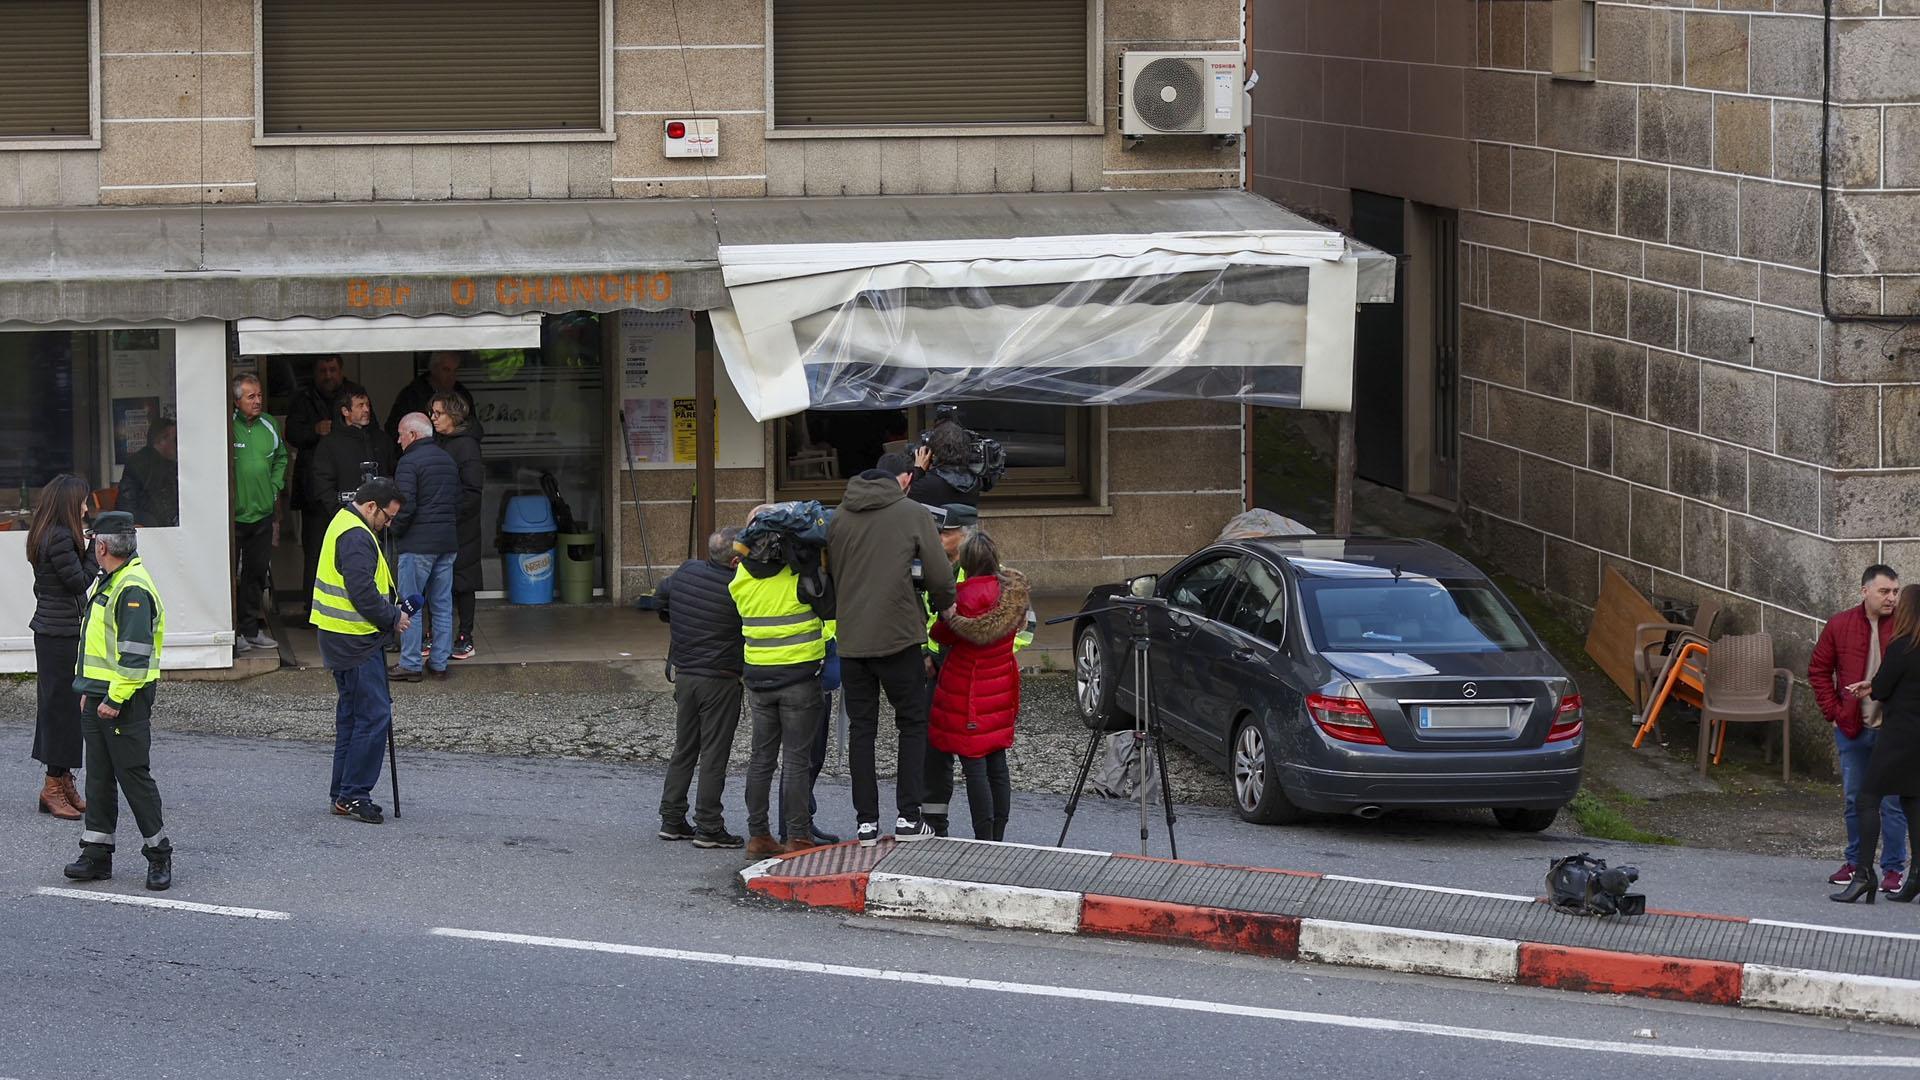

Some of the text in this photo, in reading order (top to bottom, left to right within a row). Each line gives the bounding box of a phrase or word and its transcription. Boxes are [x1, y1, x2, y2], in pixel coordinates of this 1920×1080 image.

[347, 271, 673, 308] Bar O CHANCHO
[675, 411, 699, 419] PARE
